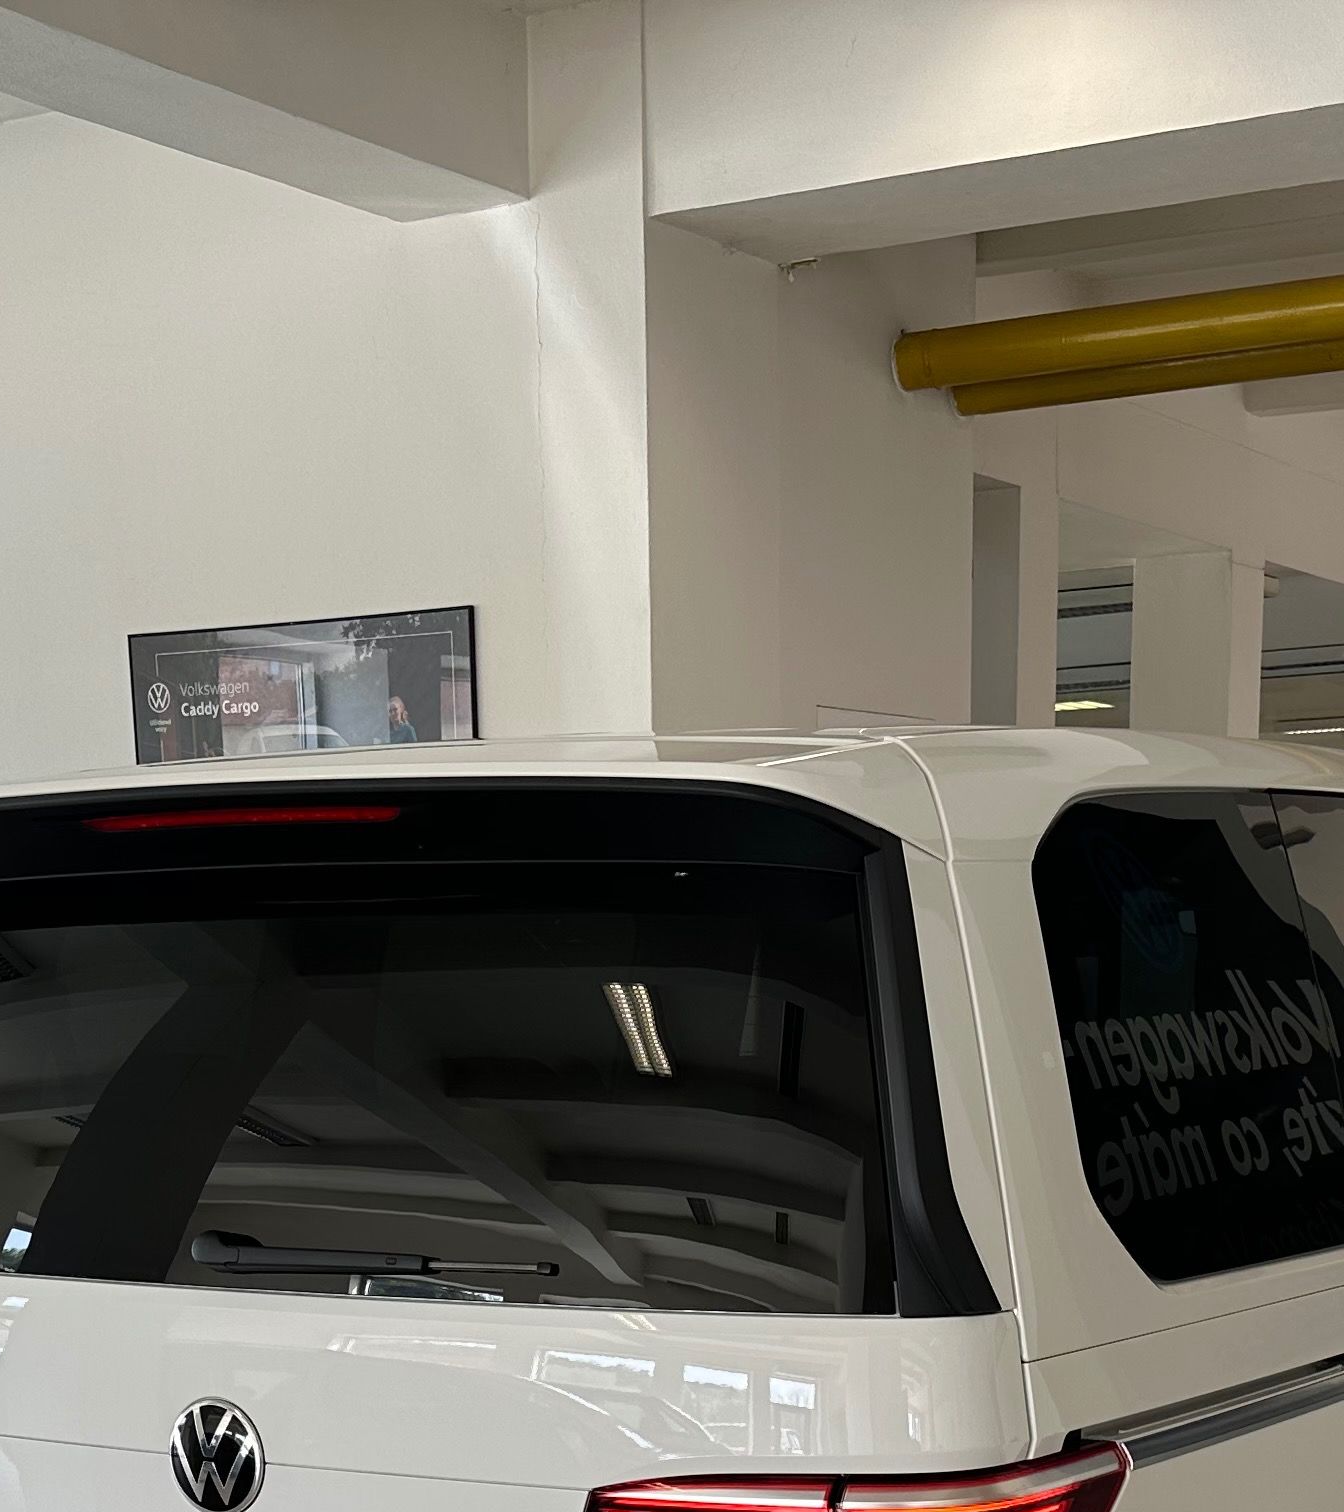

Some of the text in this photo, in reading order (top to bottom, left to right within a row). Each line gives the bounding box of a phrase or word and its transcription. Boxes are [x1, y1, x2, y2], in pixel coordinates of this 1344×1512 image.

[179, 681, 249, 697] Volkswagen
[181, 700, 259, 718] Caddy Cargo
